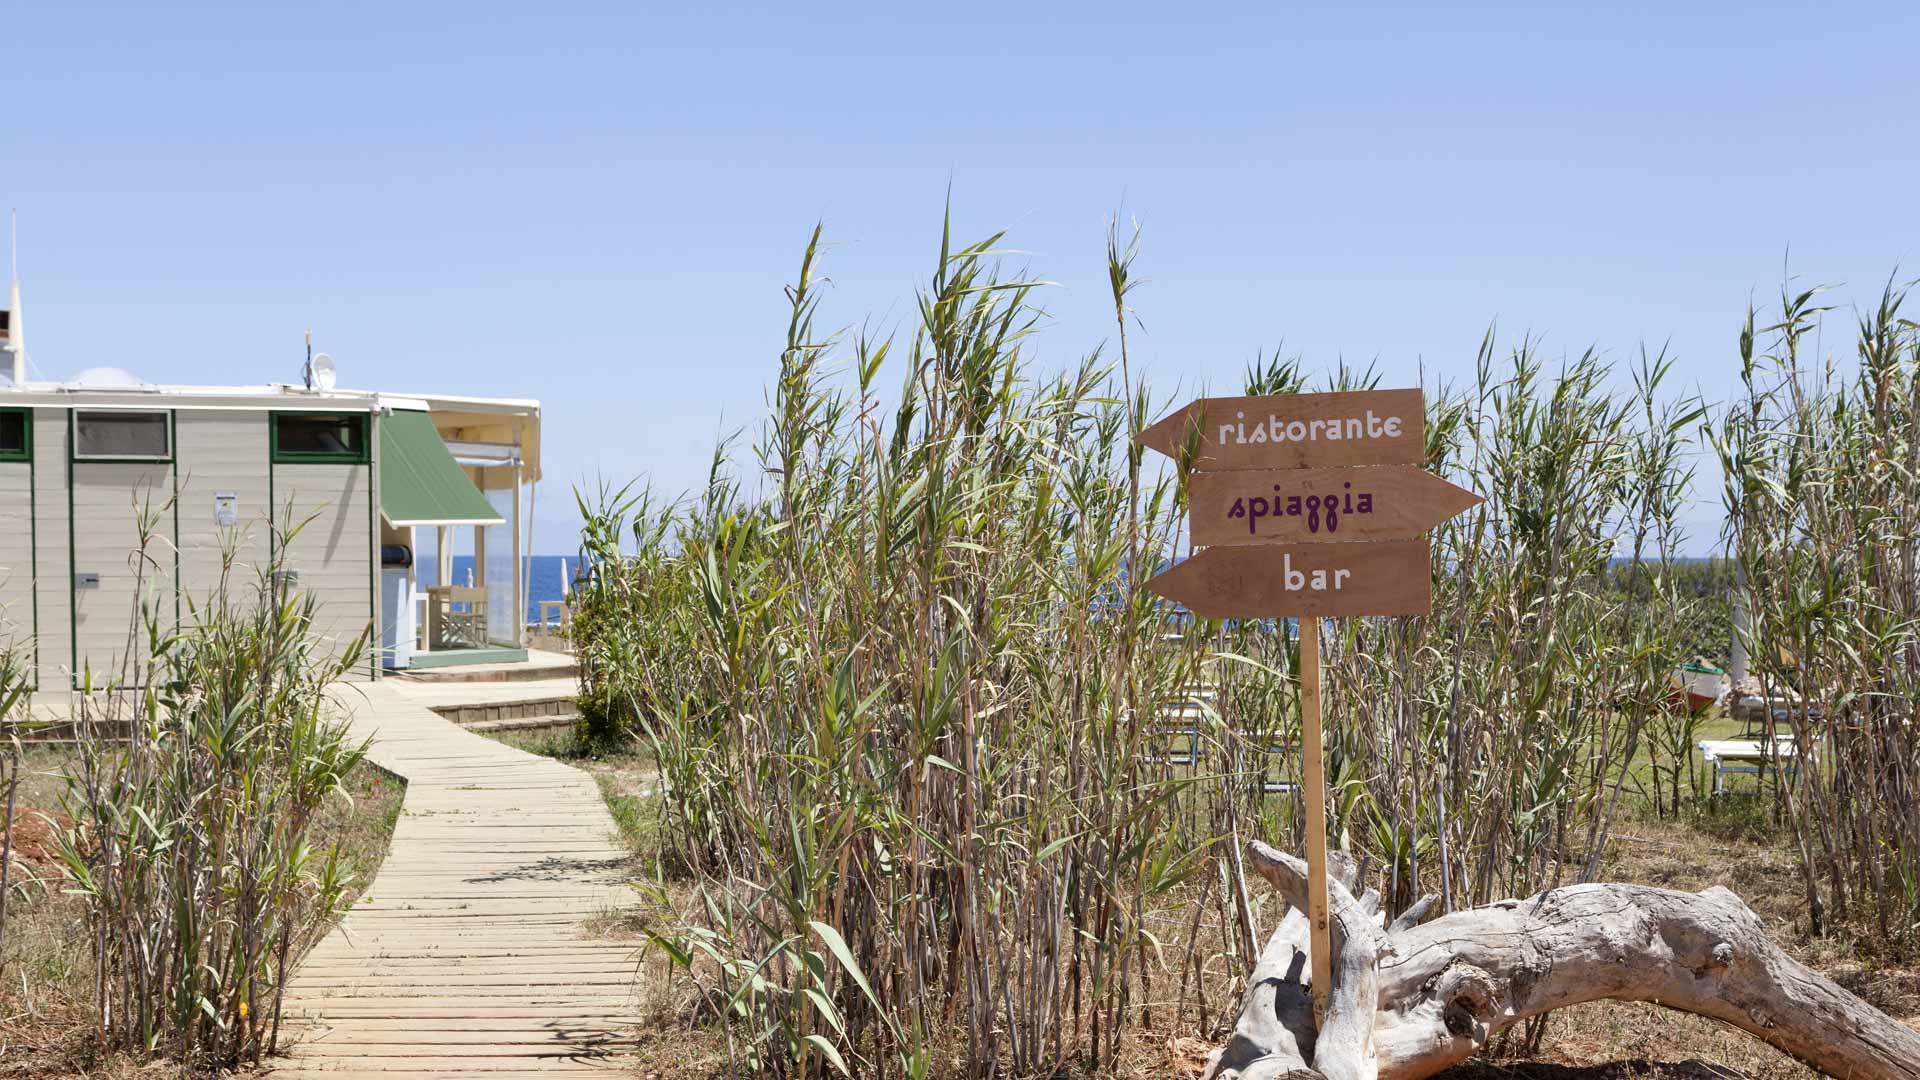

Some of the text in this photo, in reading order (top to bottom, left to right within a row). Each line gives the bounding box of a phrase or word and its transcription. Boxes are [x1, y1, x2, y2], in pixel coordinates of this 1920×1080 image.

[1218, 409, 1402, 445] ristorante
[1227, 482, 1373, 534] spiaggia
[1284, 553, 1351, 592] bar
